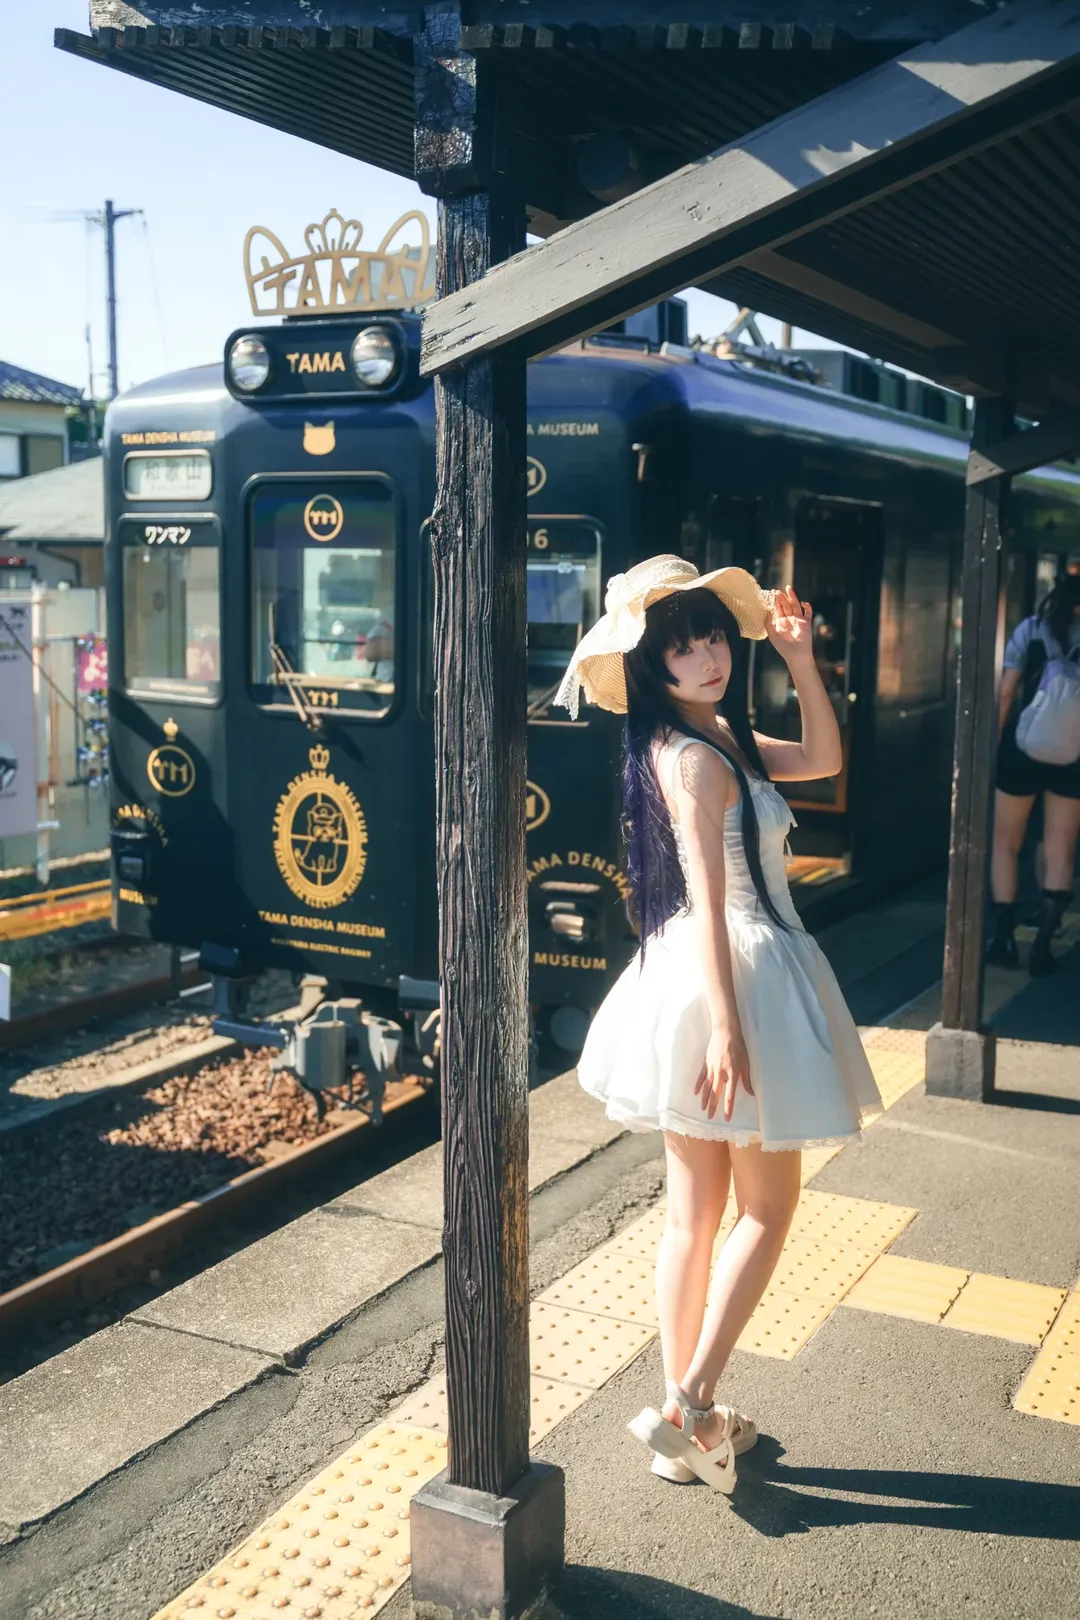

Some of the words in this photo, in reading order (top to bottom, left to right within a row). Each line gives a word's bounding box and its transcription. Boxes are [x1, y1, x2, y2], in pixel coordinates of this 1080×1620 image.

[262, 258, 412, 307] TAMA
[286, 352, 346, 373] TAMA
[538, 422, 599, 436] MUSEUM
[145, 526, 192, 545] ワンマン
[526, 853, 563, 884] AMA
[568, 851, 634, 899] DENSHA
[258, 910, 289, 925] TAMA
[289, 915, 335, 932] DENSHA
[336, 921, 386, 938] MUSEUM
[533, 951, 607, 970] MUSEUM
